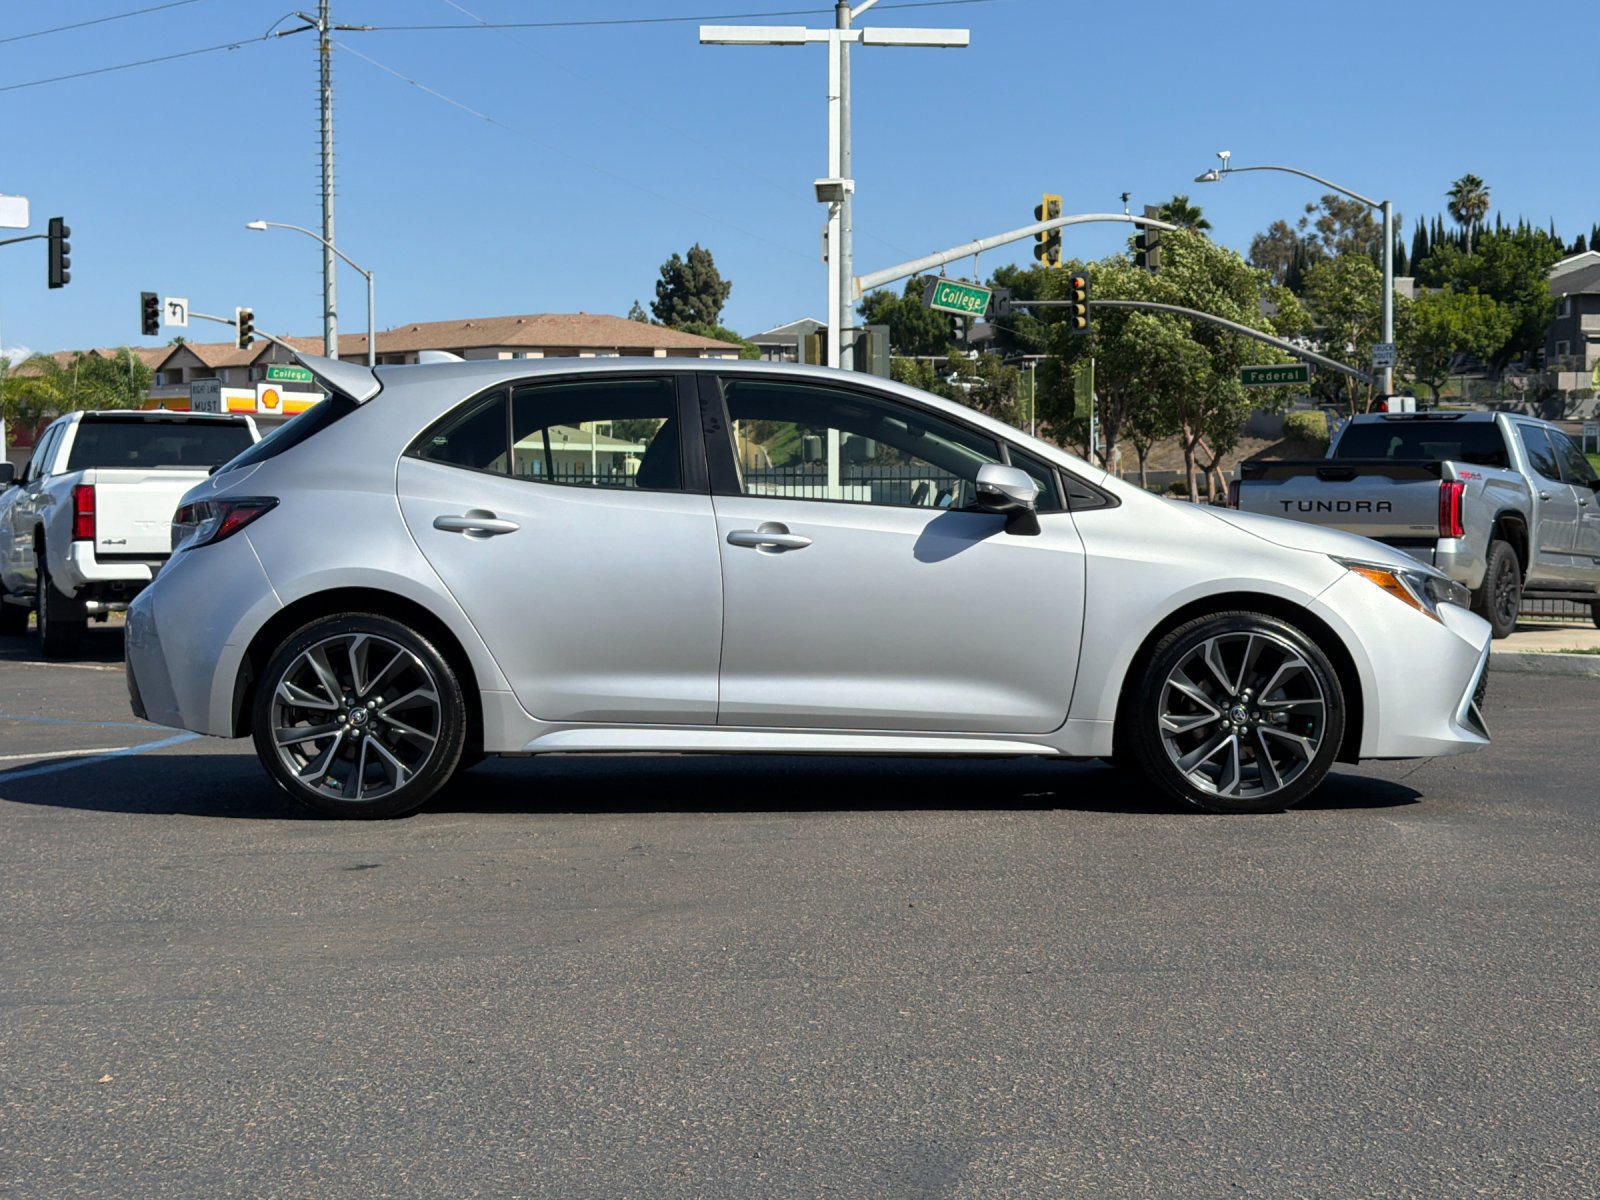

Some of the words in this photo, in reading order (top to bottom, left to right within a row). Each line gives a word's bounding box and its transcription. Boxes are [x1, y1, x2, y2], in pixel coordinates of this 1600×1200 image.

[941, 288, 981, 311] College
[273, 369, 307, 379] College
[1250, 370, 1299, 382] Federal
[194, 401, 217, 412] MUST
[1280, 500, 1393, 513] TUNDRA
